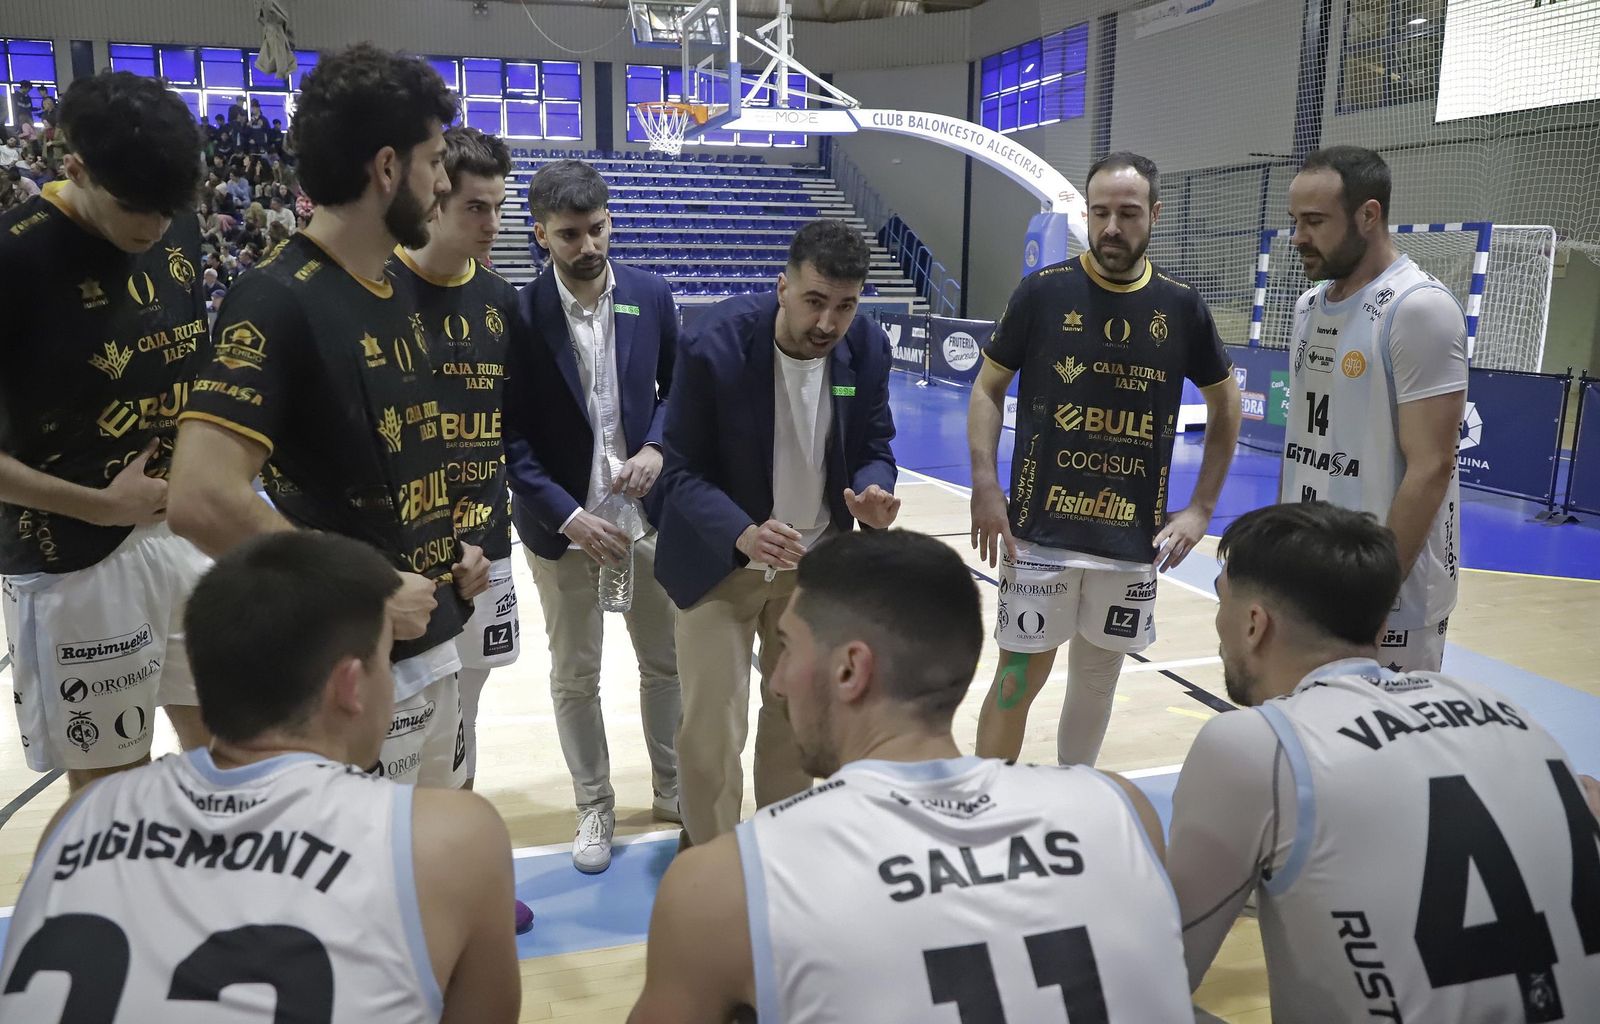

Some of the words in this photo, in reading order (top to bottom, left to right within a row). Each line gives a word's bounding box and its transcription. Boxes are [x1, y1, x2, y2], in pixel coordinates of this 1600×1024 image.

[872, 112, 903, 127] CLUB
[908, 115, 985, 146] BALONCESTO
[986, 139, 1044, 179] ALGECIRAS
[138, 331, 171, 352] CAJA
[442, 363, 472, 375] CAJA
[477, 363, 504, 376] RURA
[465, 375, 495, 390] JAÉN
[1093, 361, 1126, 376] CAJA
[1129, 365, 1168, 383] RURAL
[1114, 377, 1149, 393] JAÉN
[440, 408, 501, 440] BULÉ
[1085, 407, 1154, 440] BULÉ
[1306, 392, 1330, 436] 14
[453, 496, 492, 528] Élite
[1045, 485, 1137, 521] FisioÉlite
[1009, 582, 1068, 595] OROBAILÉN
[1112, 611, 1134, 628] LZ
[62, 628, 149, 660] Rapimueble
[489, 627, 509, 646] LZ
[91, 657, 161, 694] OROBAILÉN
[1337, 697, 1529, 751] VALEIRAS
[54, 819, 352, 894] SIGISMONTI
[877, 830, 1085, 903] SALAS
